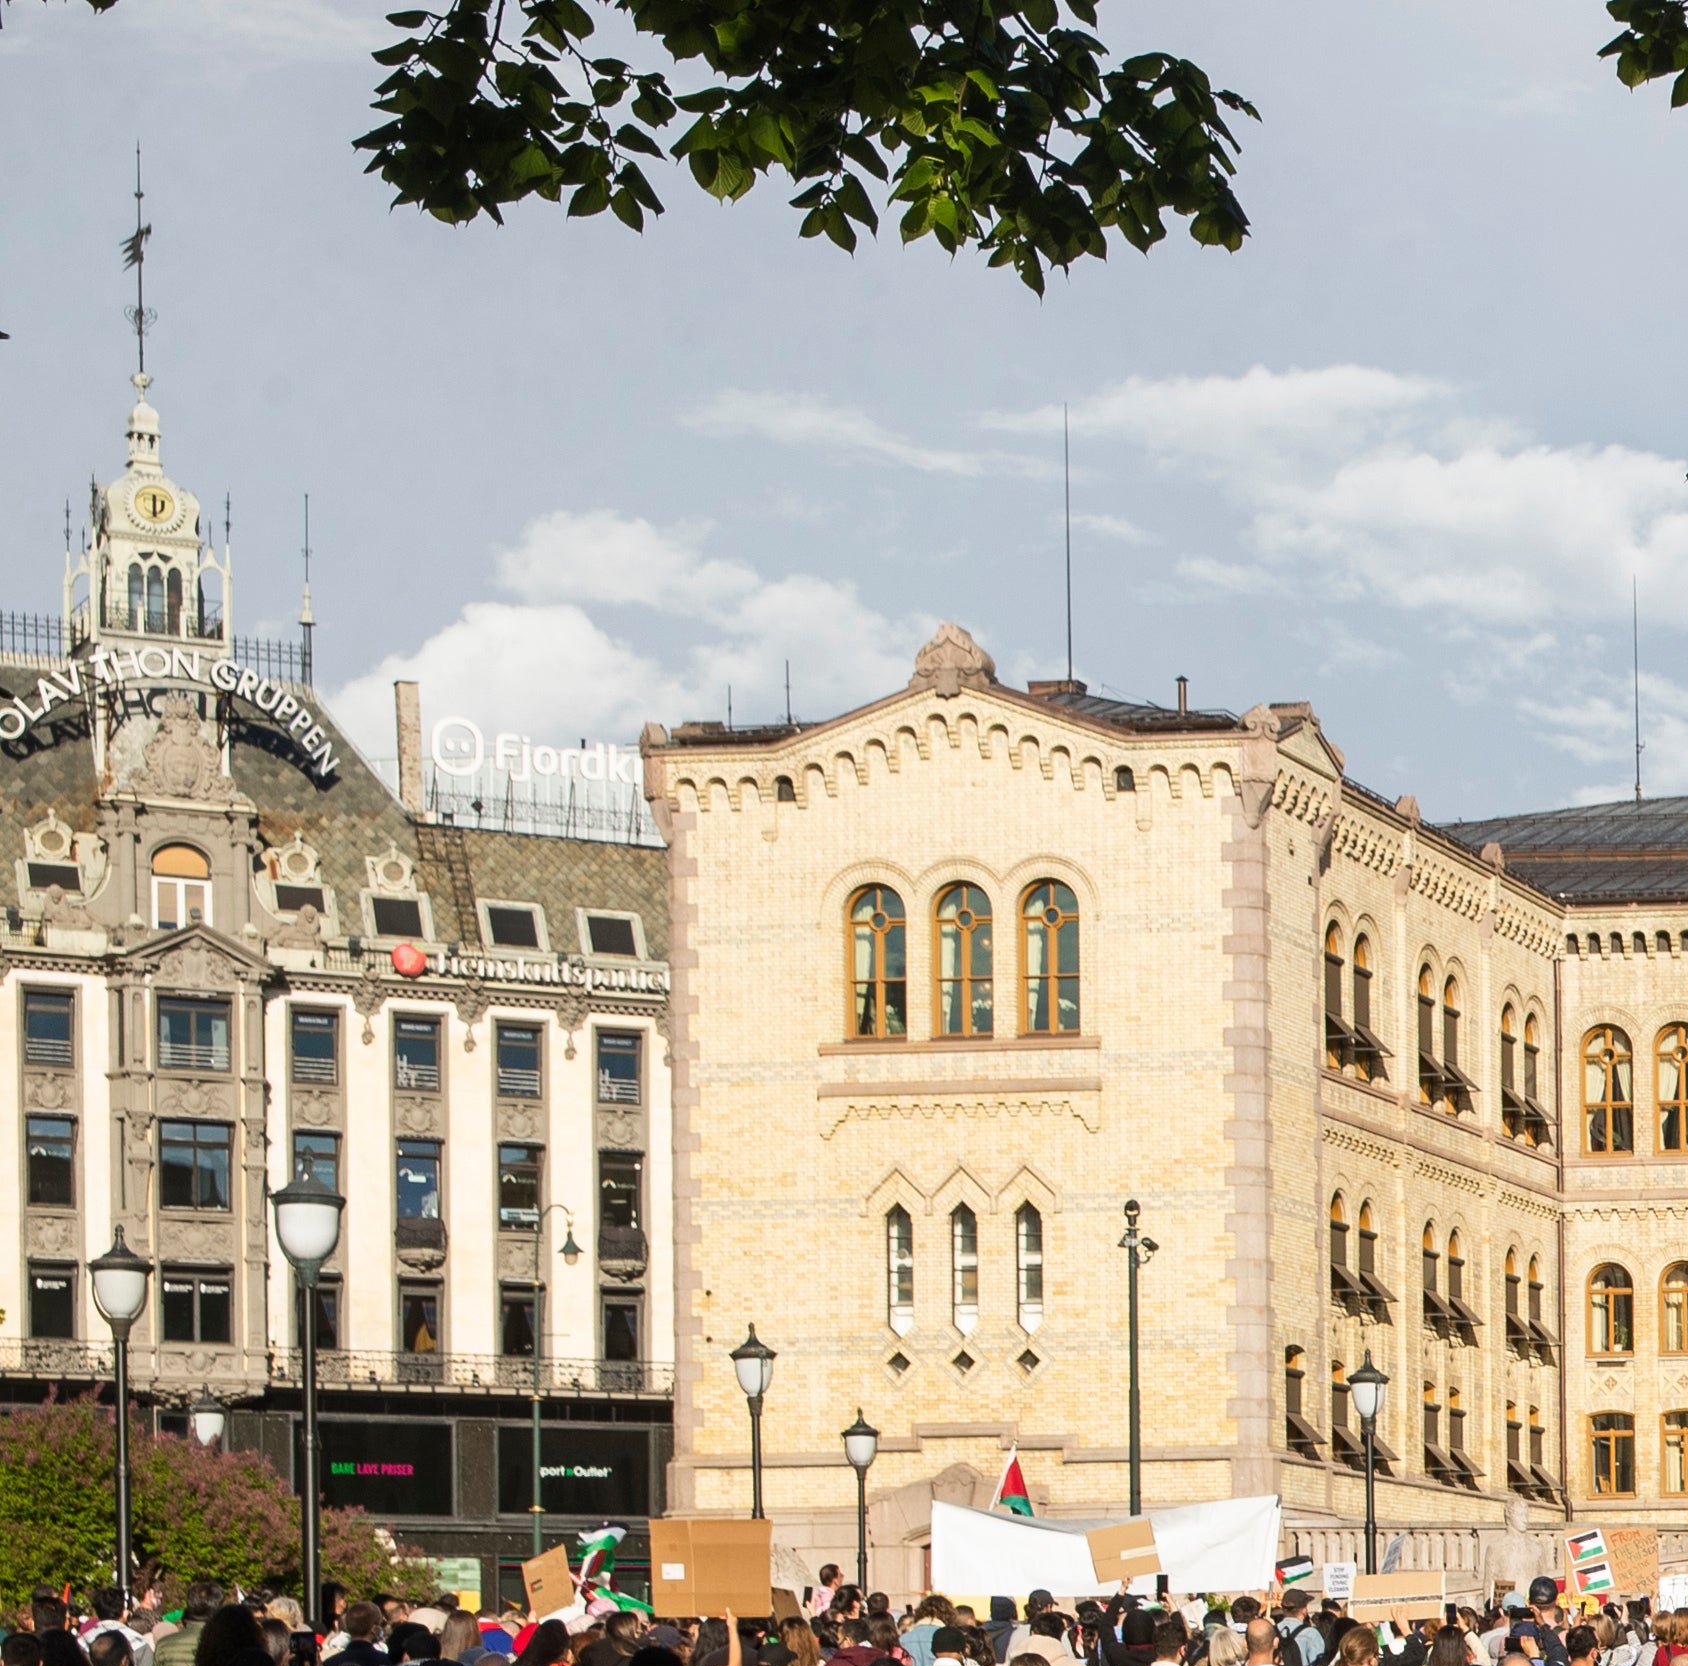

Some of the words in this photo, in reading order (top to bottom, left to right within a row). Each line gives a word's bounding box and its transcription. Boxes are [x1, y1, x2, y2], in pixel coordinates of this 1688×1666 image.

[0, 661, 82, 740] OLAV
[89, 645, 200, 684] THON
[210, 658, 341, 777] GRUPPEN
[539, 1465, 565, 1478] port
